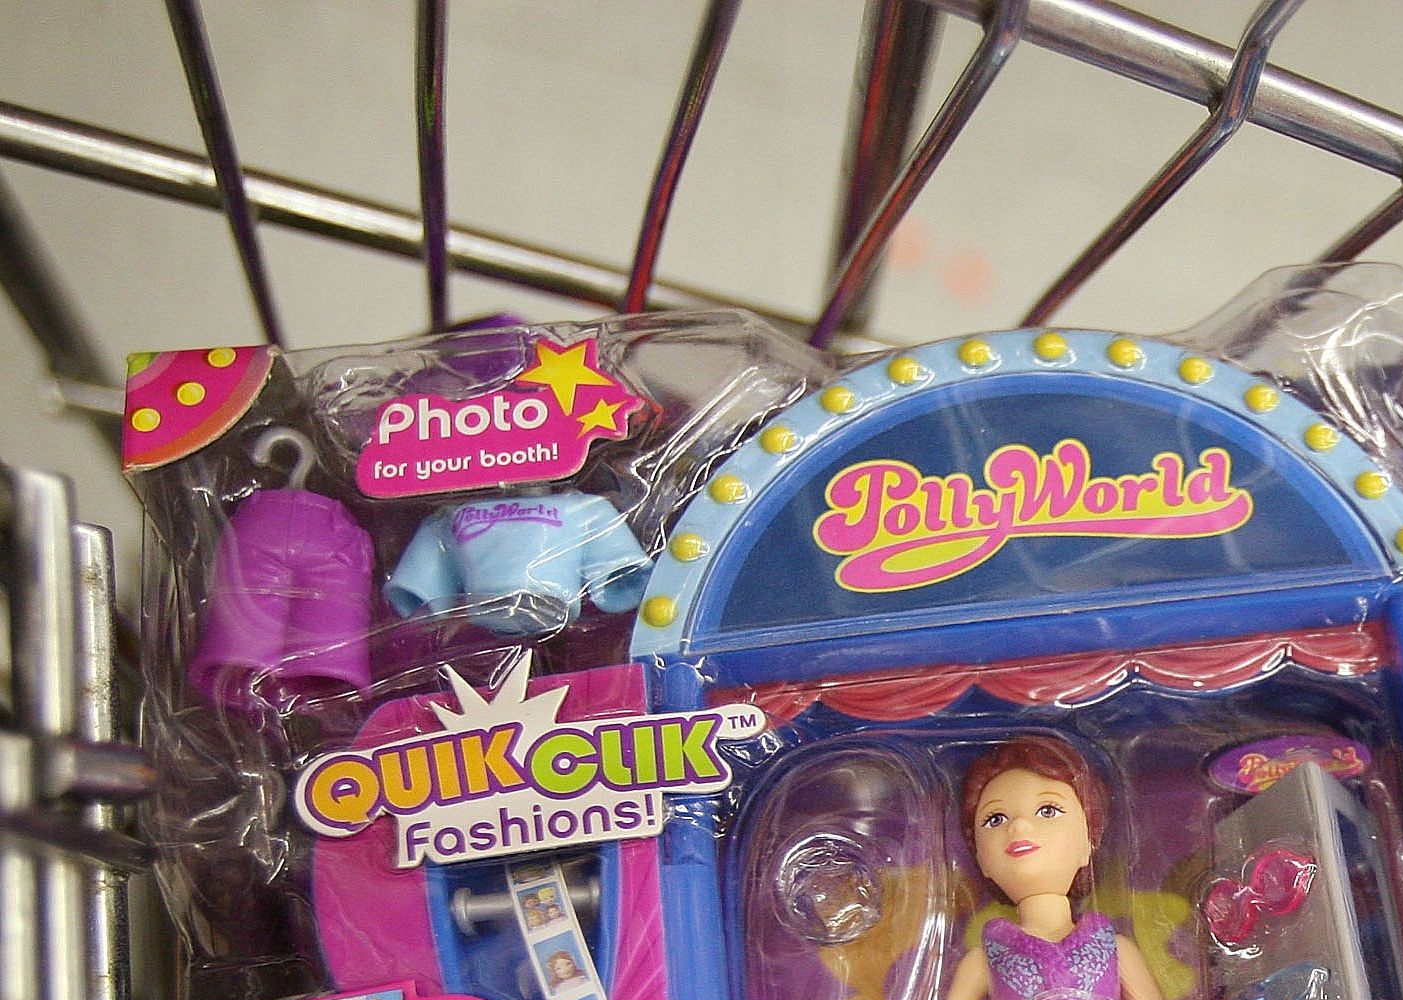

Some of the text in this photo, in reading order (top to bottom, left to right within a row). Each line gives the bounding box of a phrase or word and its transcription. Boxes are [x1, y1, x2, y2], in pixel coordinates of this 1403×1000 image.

[378, 394, 548, 446] Photo
[373, 442, 559, 482] for your booth!
[813, 438, 1253, 593] PollyWorld
[307, 722, 522, 830] QUIK
[525, 714, 726, 798] CLIK
[404, 799, 657, 863] Fashions!
